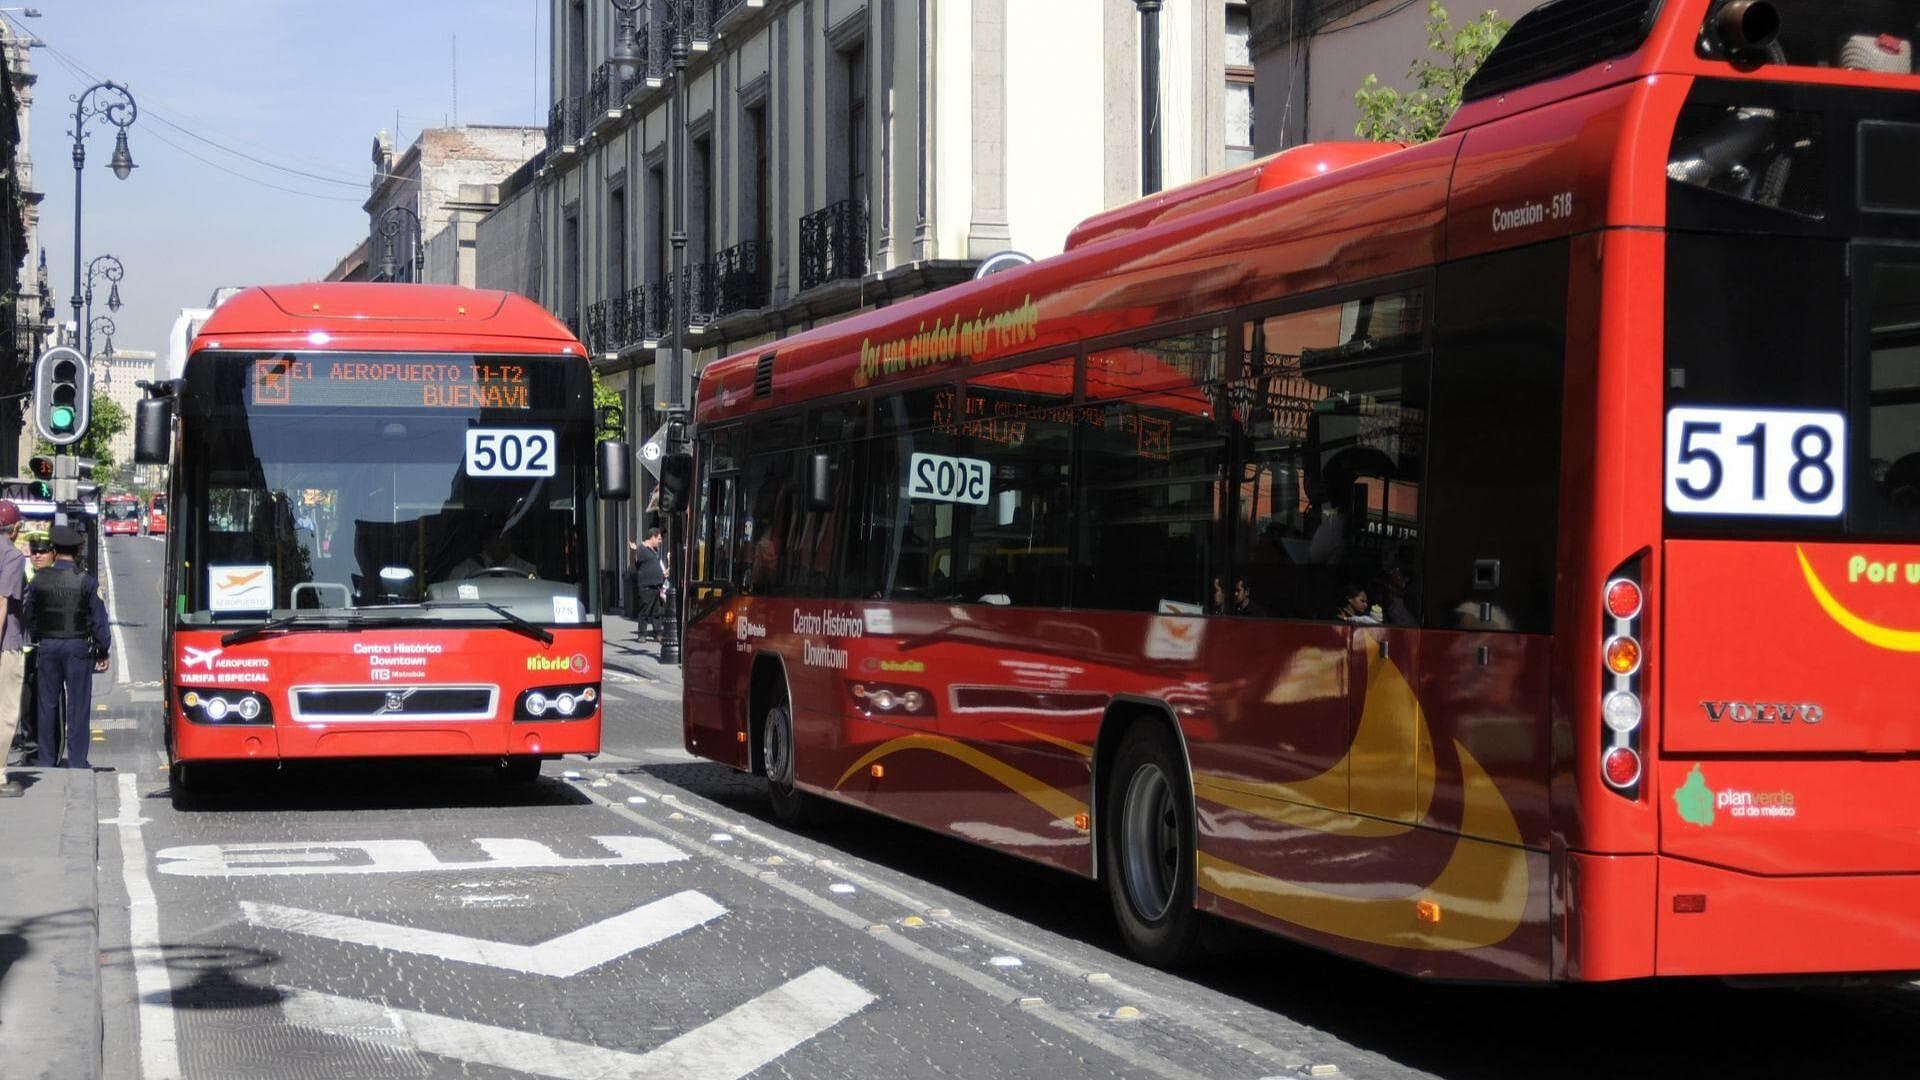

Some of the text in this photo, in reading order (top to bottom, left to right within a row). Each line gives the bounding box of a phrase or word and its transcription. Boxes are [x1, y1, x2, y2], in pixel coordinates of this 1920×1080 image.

[1492, 201, 1543, 232] Conexion
[1552, 192, 1572, 219] 518
[861, 338, 880, 384] Por
[883, 338, 906, 375] una
[909, 314, 959, 369] ciudad
[993, 293, 1038, 349] verde
[292, 363, 523, 383] E1 AEROPUERTO T1-T2
[473, 434, 549, 471] 502
[1675, 420, 1834, 504] 518
[1848, 555, 1897, 583] Por
[793, 608, 863, 638] Centro Histórico
[353, 642, 442, 653] Centro Histórico
[370, 655, 426, 666] Downtown
[804, 639, 848, 670] Downtown
[216, 659, 269, 668] AEROPUERTO
[181, 673, 269, 683] TARIFA ESPECIAL
[1700, 700, 1825, 724] VOLVO
[1732, 806, 1746, 817] cd
[1747, 806, 1761, 817] de
